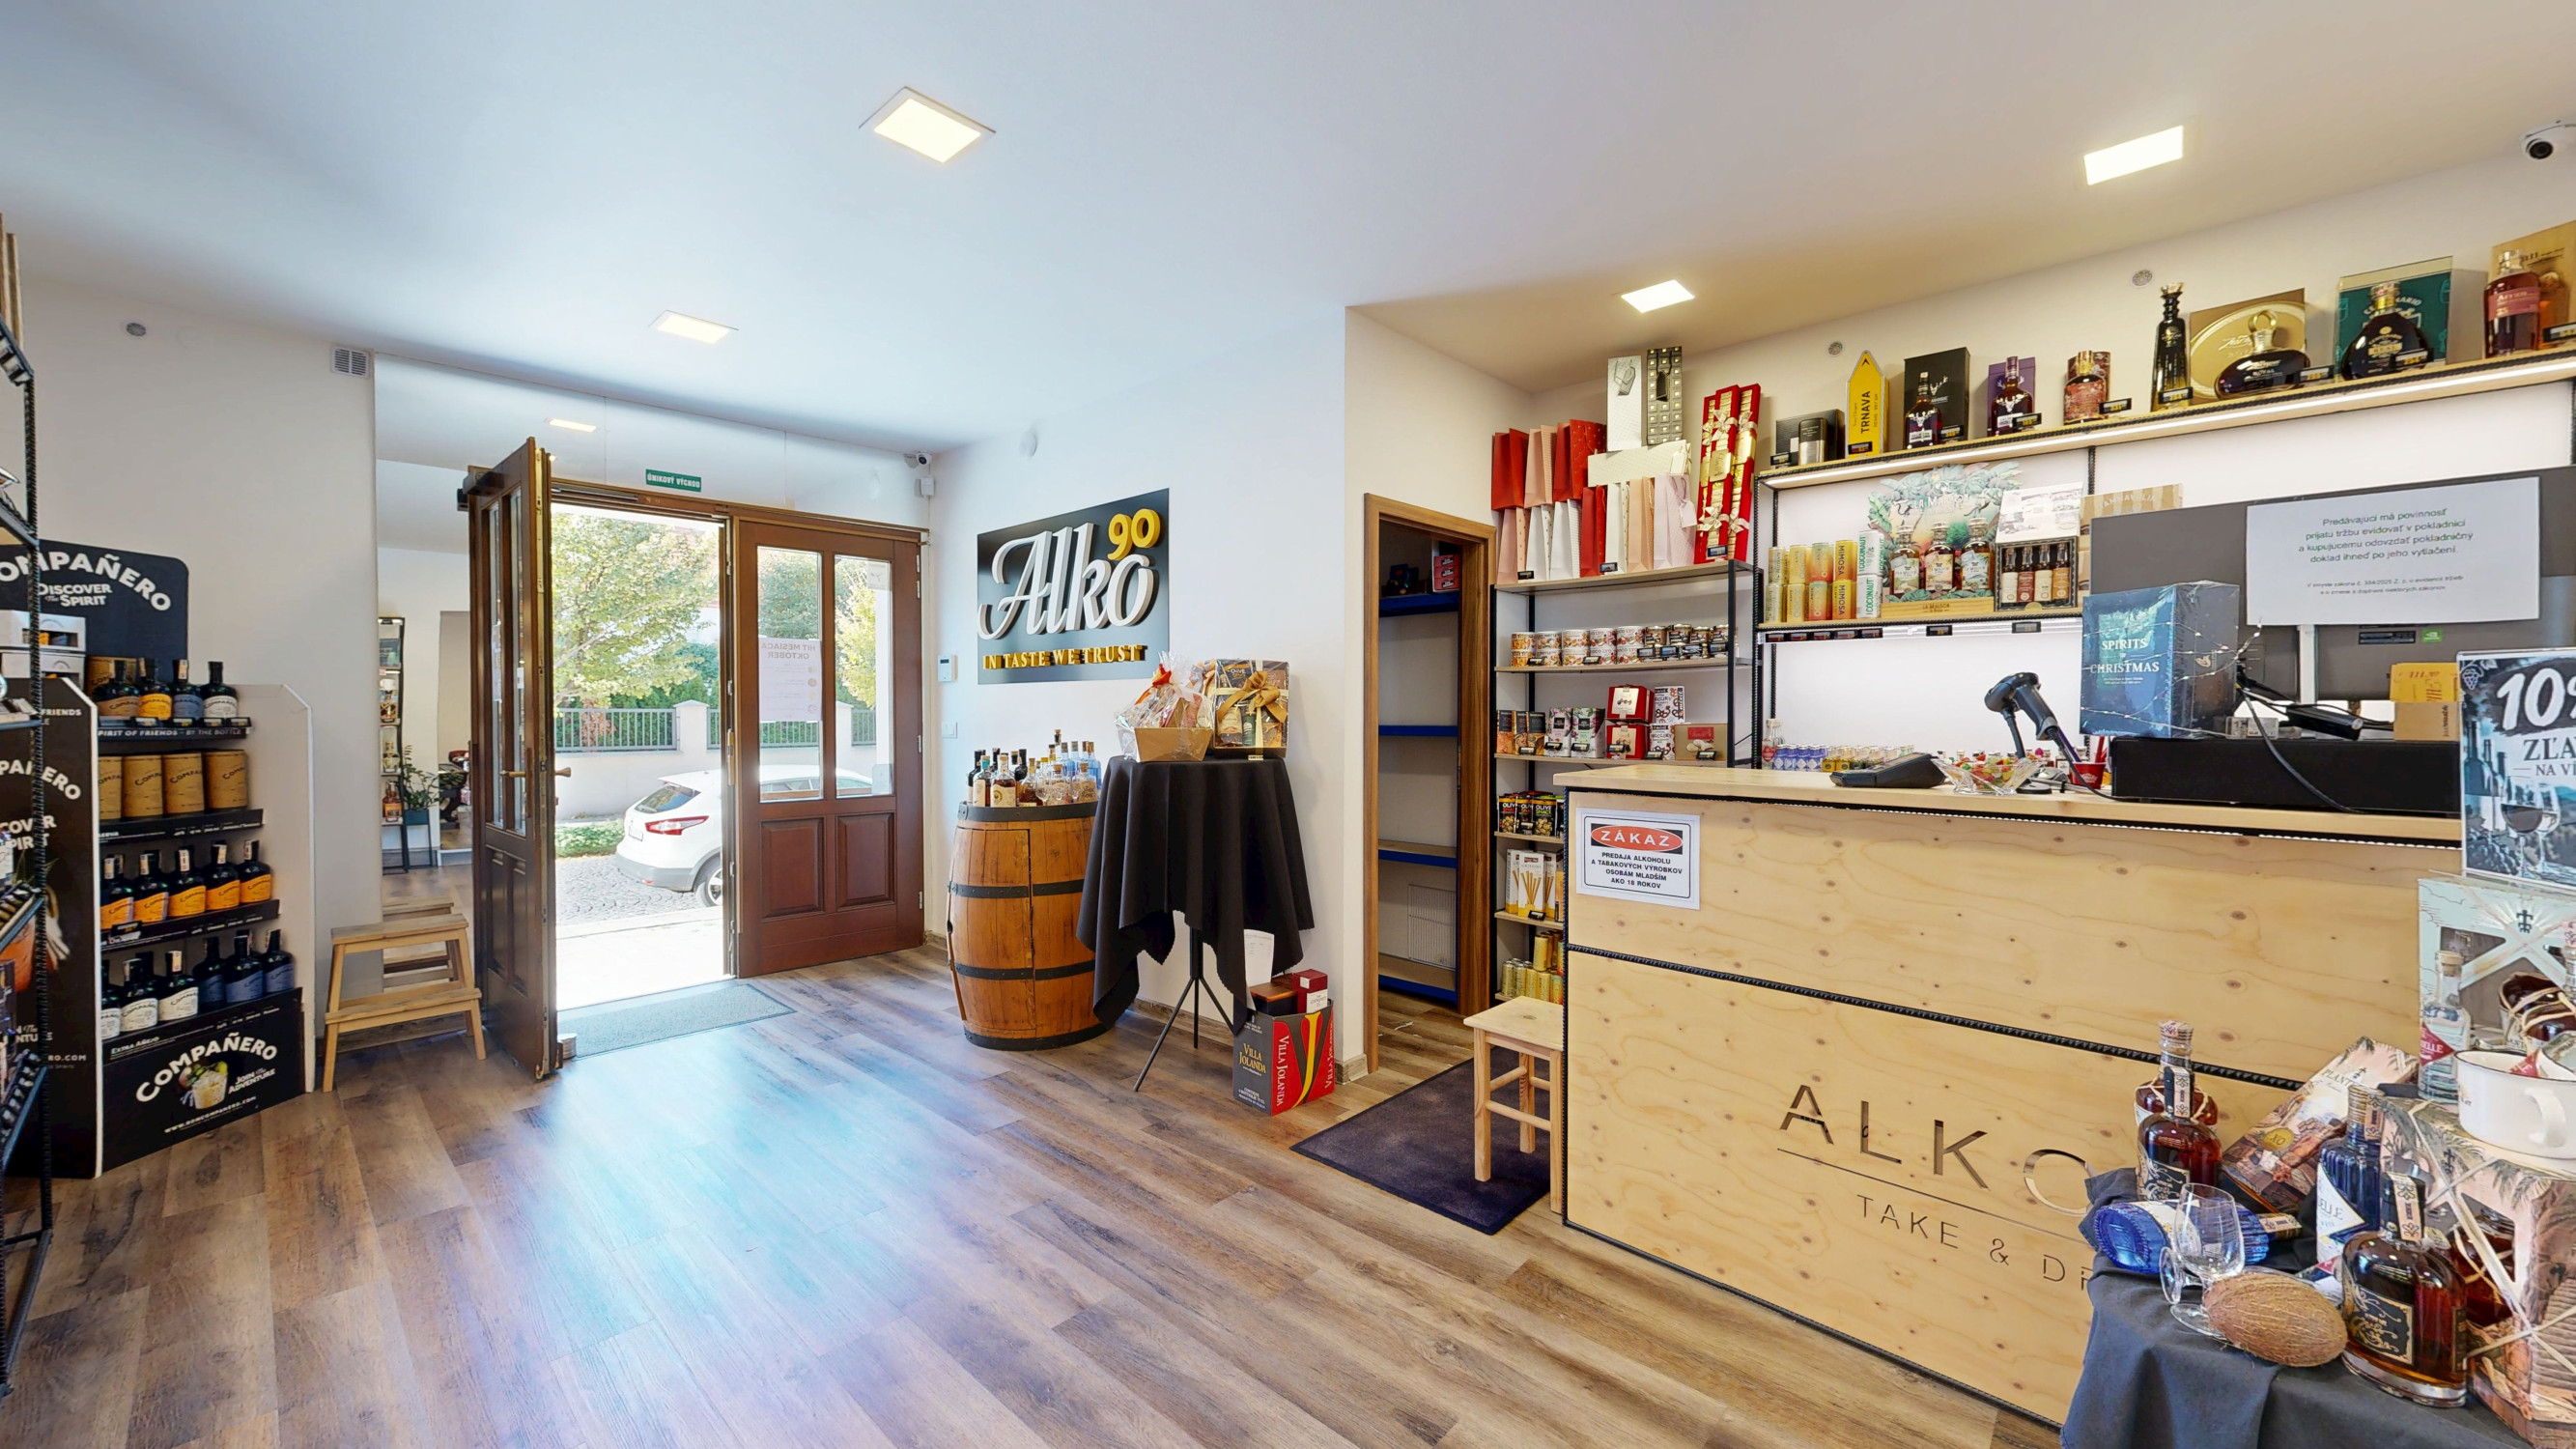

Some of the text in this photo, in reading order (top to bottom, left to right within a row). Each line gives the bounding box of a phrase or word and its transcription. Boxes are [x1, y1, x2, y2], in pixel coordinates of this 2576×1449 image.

[1860, 390, 1871, 434] TRNAVA
[676, 476, 700, 488] VÝCHOD
[1108, 508, 1160, 560] 90
[2310, 554, 2340, 563] doklad
[2387, 550, 2409, 559] jeho
[977, 523, 1154, 640] Alko
[60, 594, 107, 608] SPIRIT
[2102, 638, 2148, 651] SPIRITS
[982, 644, 1141, 670] IN TASTE WE TRUST
[2090, 662, 2160, 674] CHRISTMAS
[2523, 737, 2576, 761] ZĽA
[2535, 764, 2557, 776] NA
[1600, 830, 1670, 846] ZÁKAZ
[1598, 860, 1642, 869] TABAKOVÝCH
[1644, 865, 1683, 874] VÝROBKOV
[1633, 855, 1671, 865] ALKOHOLU
[1605, 868, 1666, 881] OSOBÁM MLADŠÍM
[1243, 1042, 1262, 1062] VILLA
[135, 1032, 277, 1102] COMPAÑERO
[1239, 1051, 1266, 1074] JOLANDA
[1276, 1035, 1289, 1107] VILLA JOLANDA
[228, 1068, 276, 1094] ADVENTURE
[1779, 1084, 2094, 1216] ALKO
[2269, 1133, 2286, 1147] XO
[1856, 1194, 1959, 1249] TAKE
[1989, 1238, 2010, 1265] &
